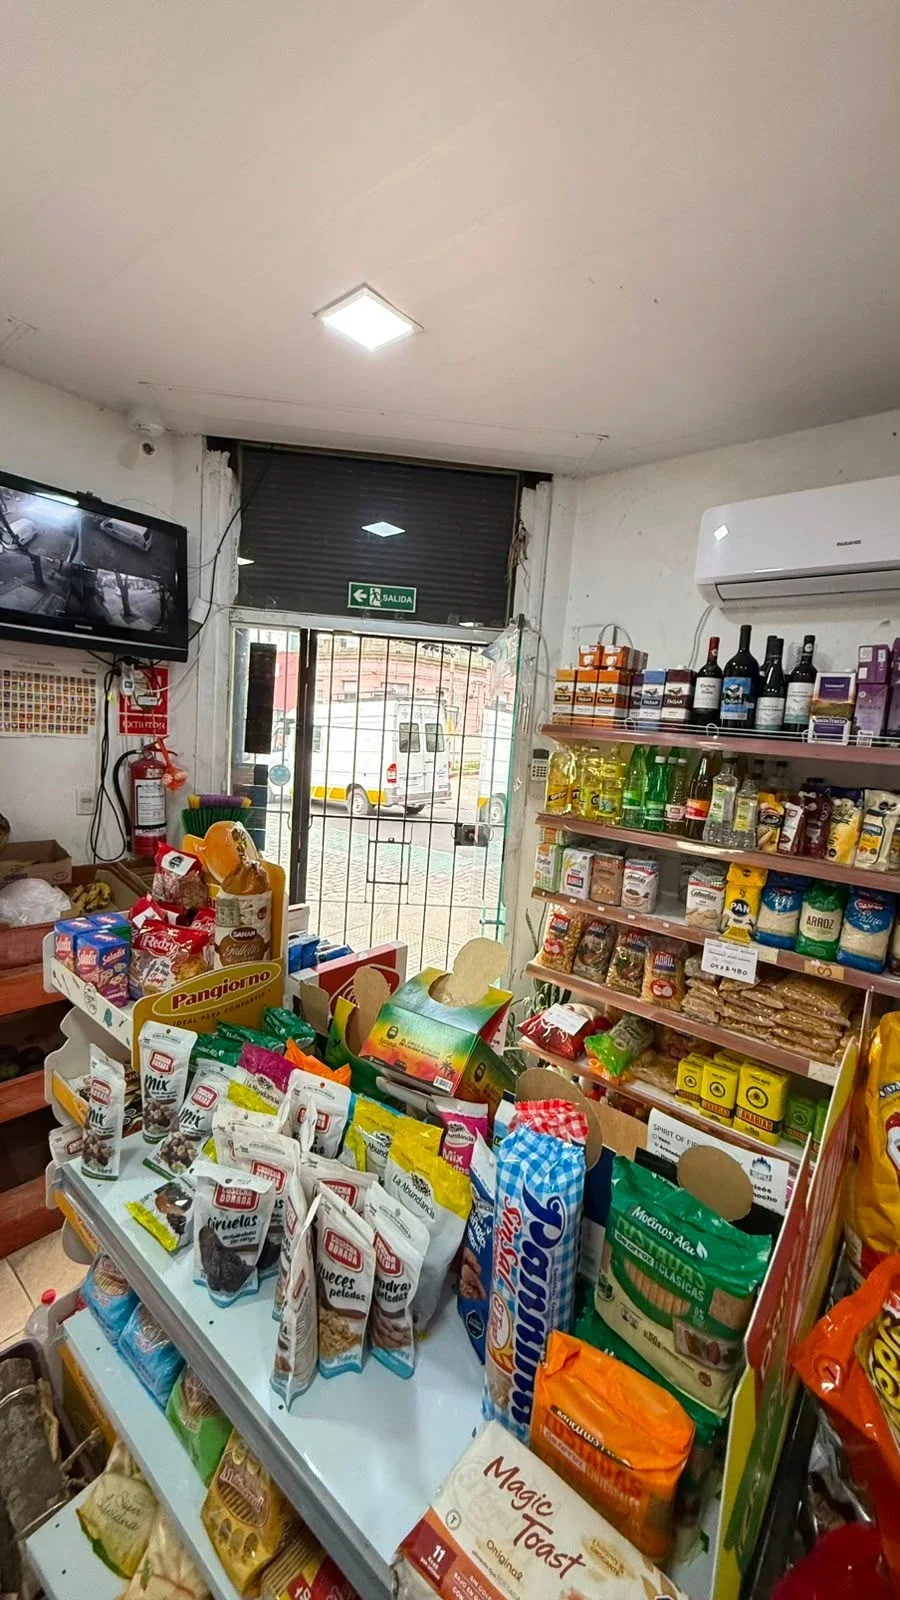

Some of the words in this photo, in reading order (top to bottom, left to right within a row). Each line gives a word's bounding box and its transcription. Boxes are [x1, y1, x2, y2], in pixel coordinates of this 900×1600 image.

[382, 594, 413, 604] SALIDA
[806, 915, 834, 930] ARROZ
[143, 935, 178, 959] Redzy
[654, 954, 675, 968] ADRIA
[171, 971, 272, 1011] Pangiorno
[201, 1012, 220, 1021] PARA
[737, 1107, 773, 1131] CANARIAS
[653, 1123, 674, 1139] SPIRIT
[675, 1133, 685, 1143] OF
[442, 1148, 464, 1164] Mix
[219, 1195, 252, 1206] DORADA
[392, 1174, 401, 1189] La
[401, 1182, 436, 1220] Abundancia
[631, 1206, 675, 1241] Molinos
[328, 1243, 358, 1265] DORADA
[330, 1233, 357, 1255] COSECHA
[617, 1216, 706, 1291] TOSTADAS
[627, 1242, 655, 1268] arroz
[329, 1286, 366, 1301] peladas
[483, 1455, 554, 1517] Magic
[433, 1544, 446, 1563] 11
[512, 1512, 587, 1580] Toast
[486, 1539, 524, 1583] Original
[452, 1571, 468, 1588] BAJO
[468, 1574, 479, 1587] SIN
